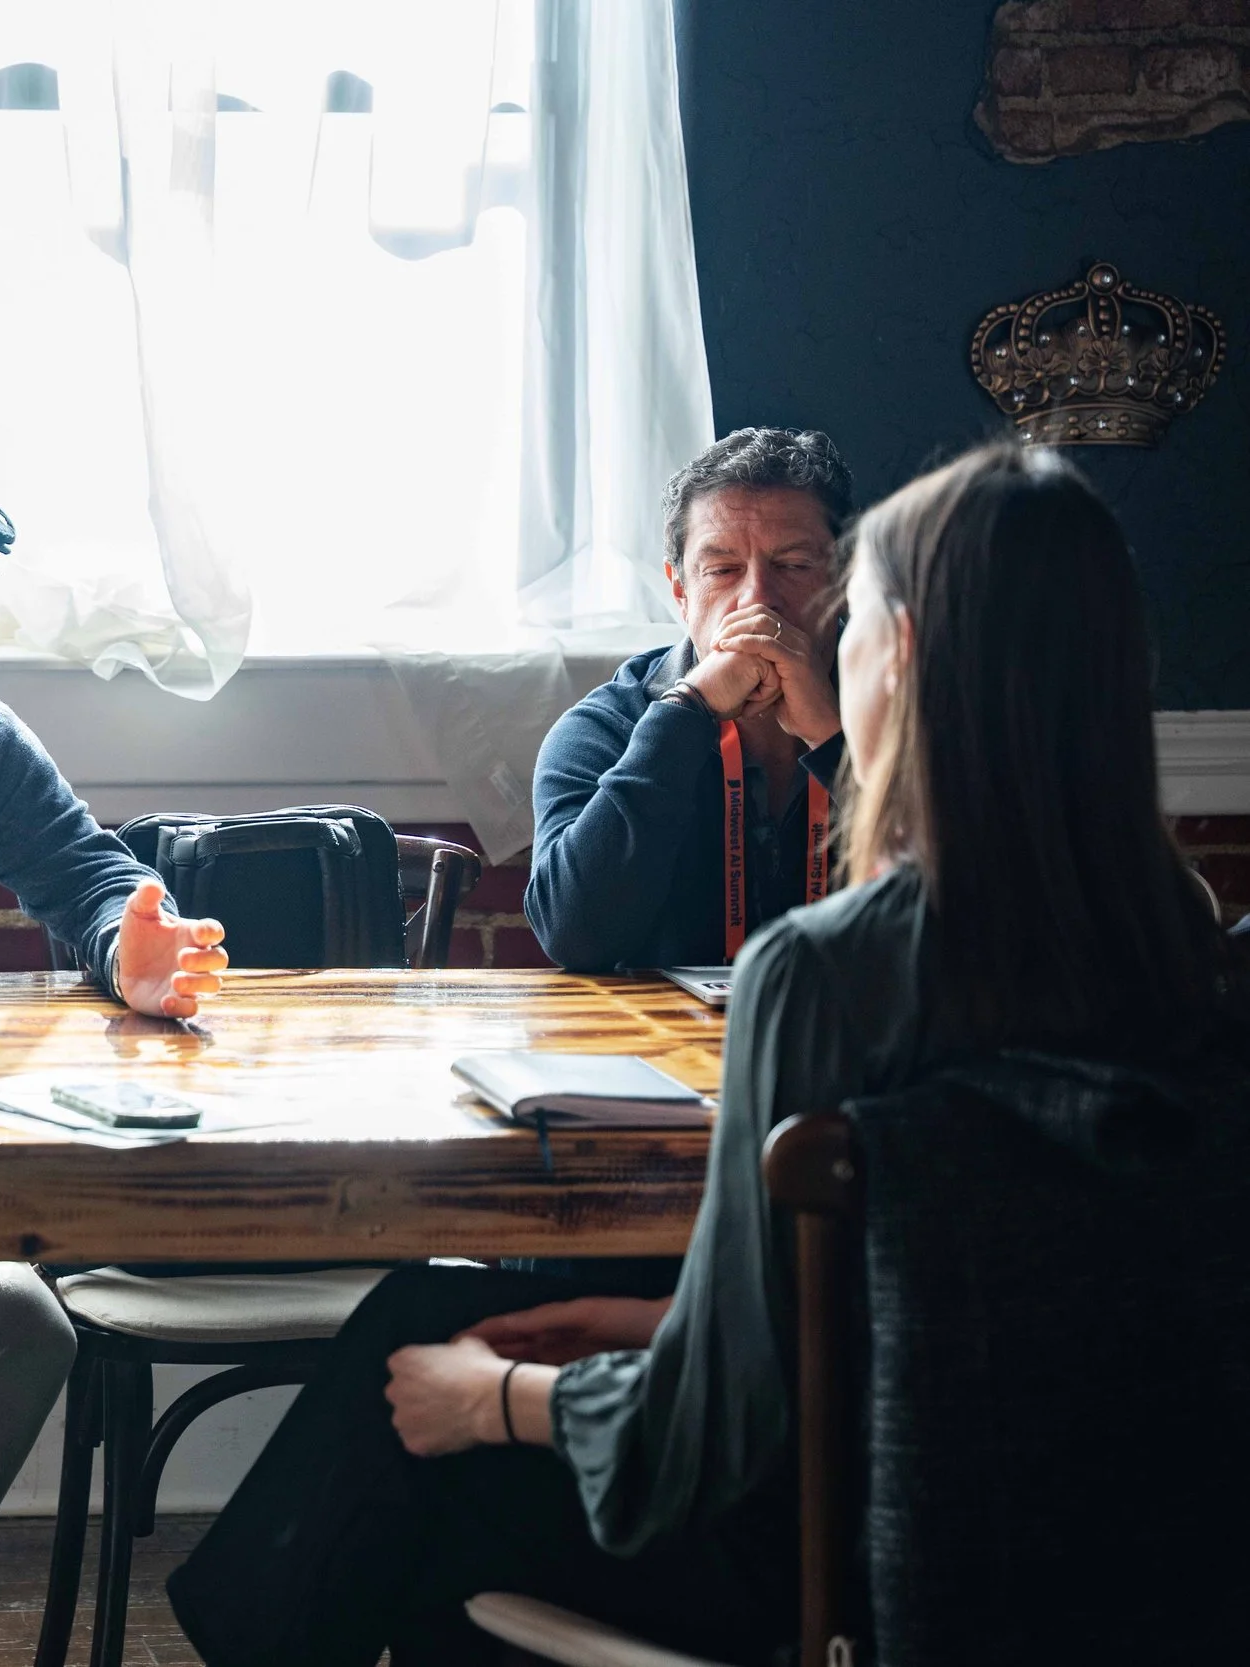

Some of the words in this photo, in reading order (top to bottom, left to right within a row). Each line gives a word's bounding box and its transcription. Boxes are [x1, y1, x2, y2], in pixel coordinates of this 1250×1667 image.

[730, 790, 742, 850] Midwest
[730, 853, 741, 868] AI
[730, 870, 742, 927] Summit
[811, 881, 822, 896] AI
